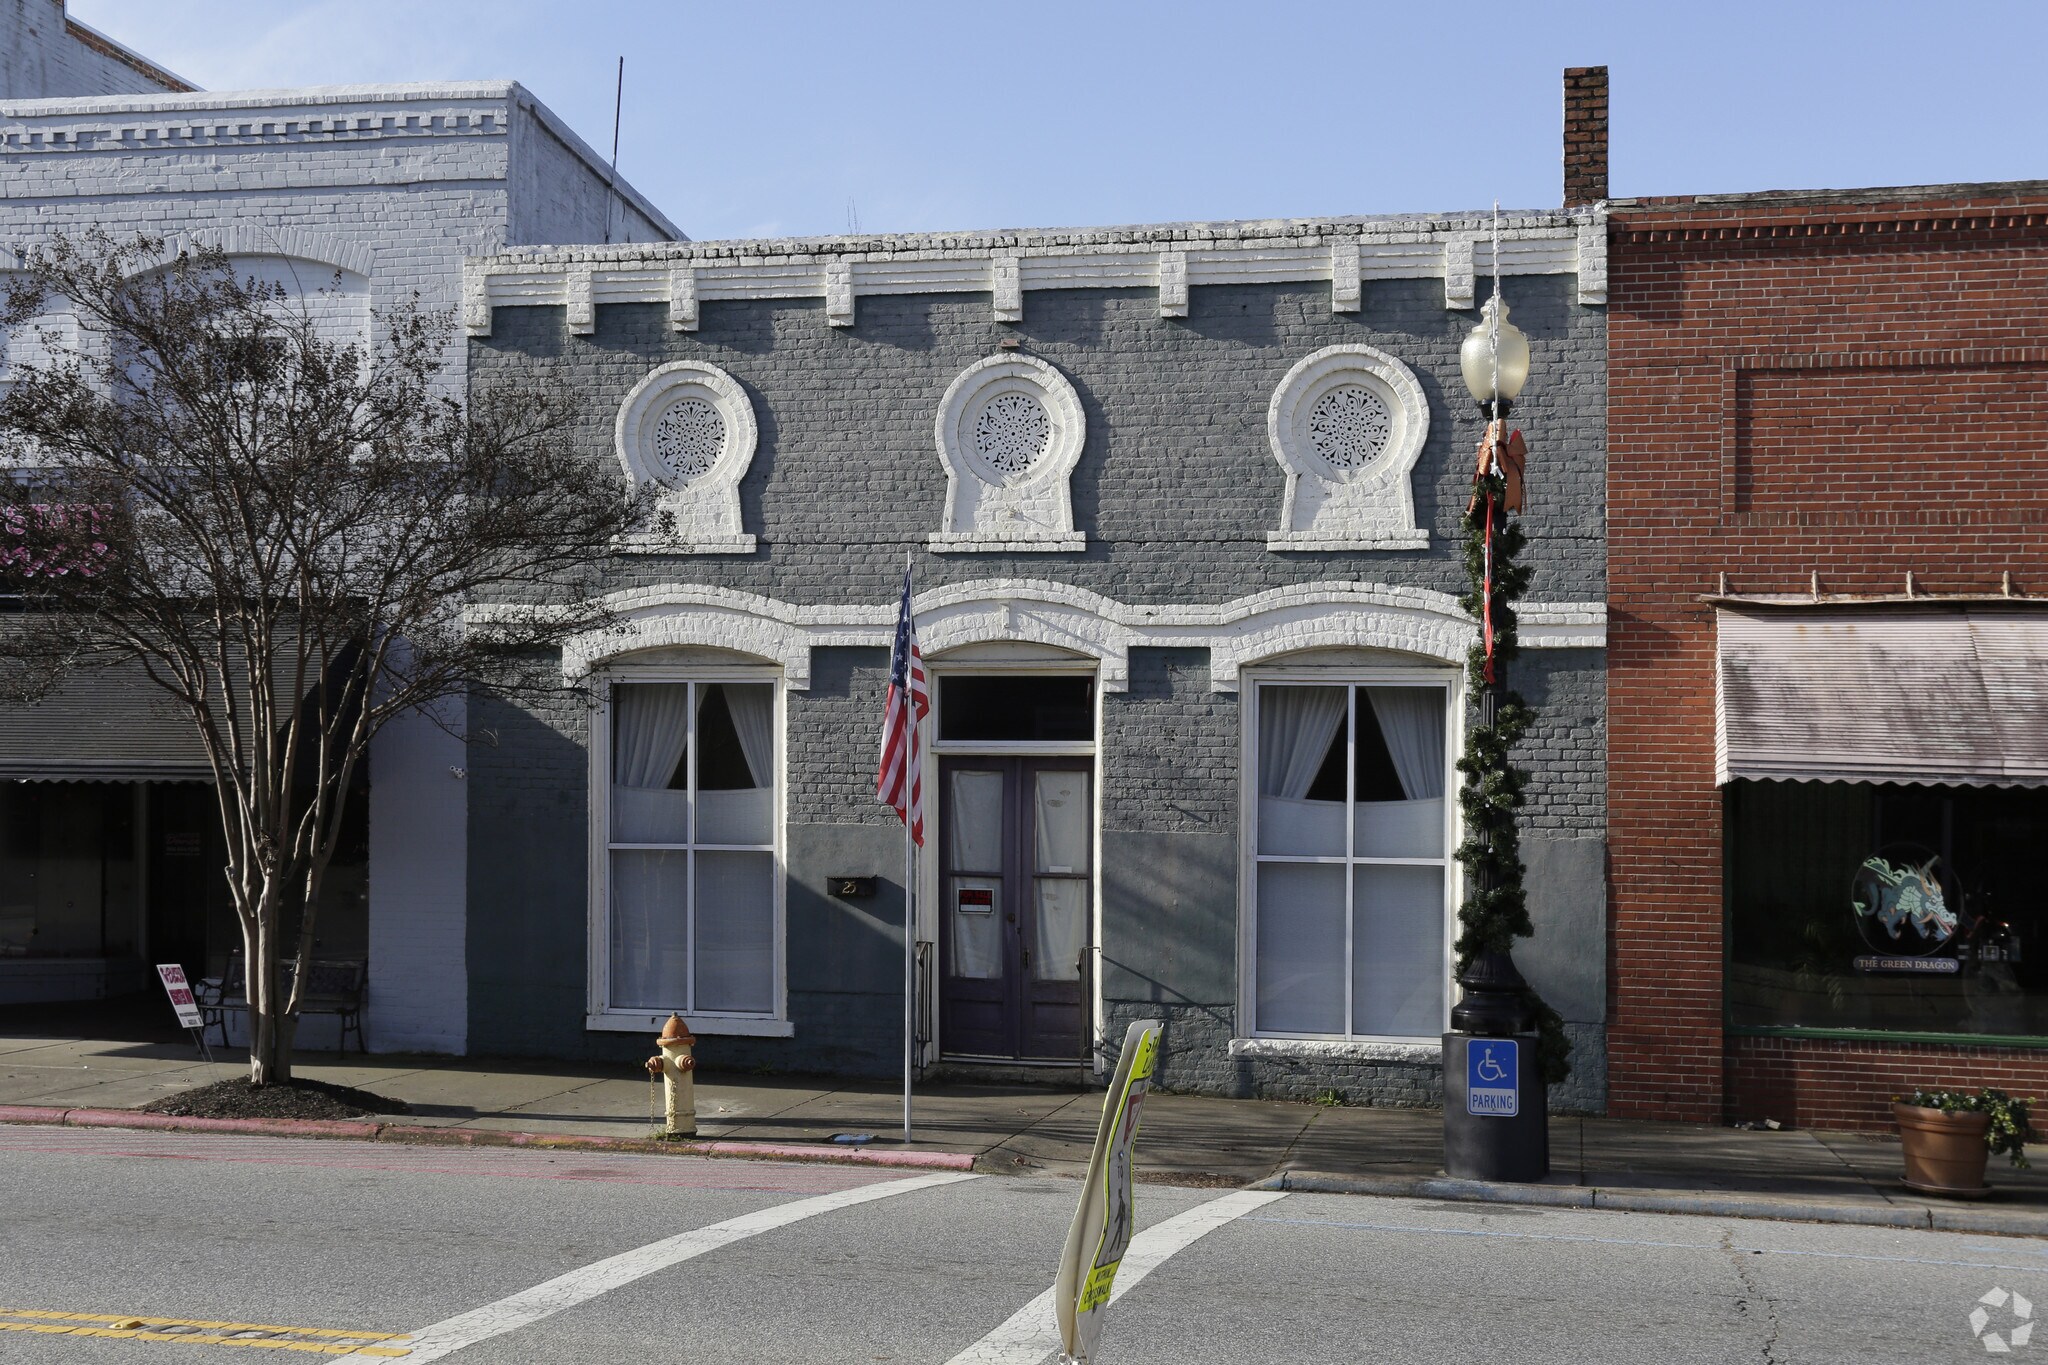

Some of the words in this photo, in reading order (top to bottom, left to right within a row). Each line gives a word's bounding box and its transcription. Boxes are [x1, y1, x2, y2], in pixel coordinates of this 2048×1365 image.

[842, 881, 857, 894] 25
[1859, 959, 1878, 968] THE
[1881, 960, 1912, 968] GREEN
[1915, 960, 1955, 969] DRAGON
[1472, 1094, 1513, 1109] PARKING
